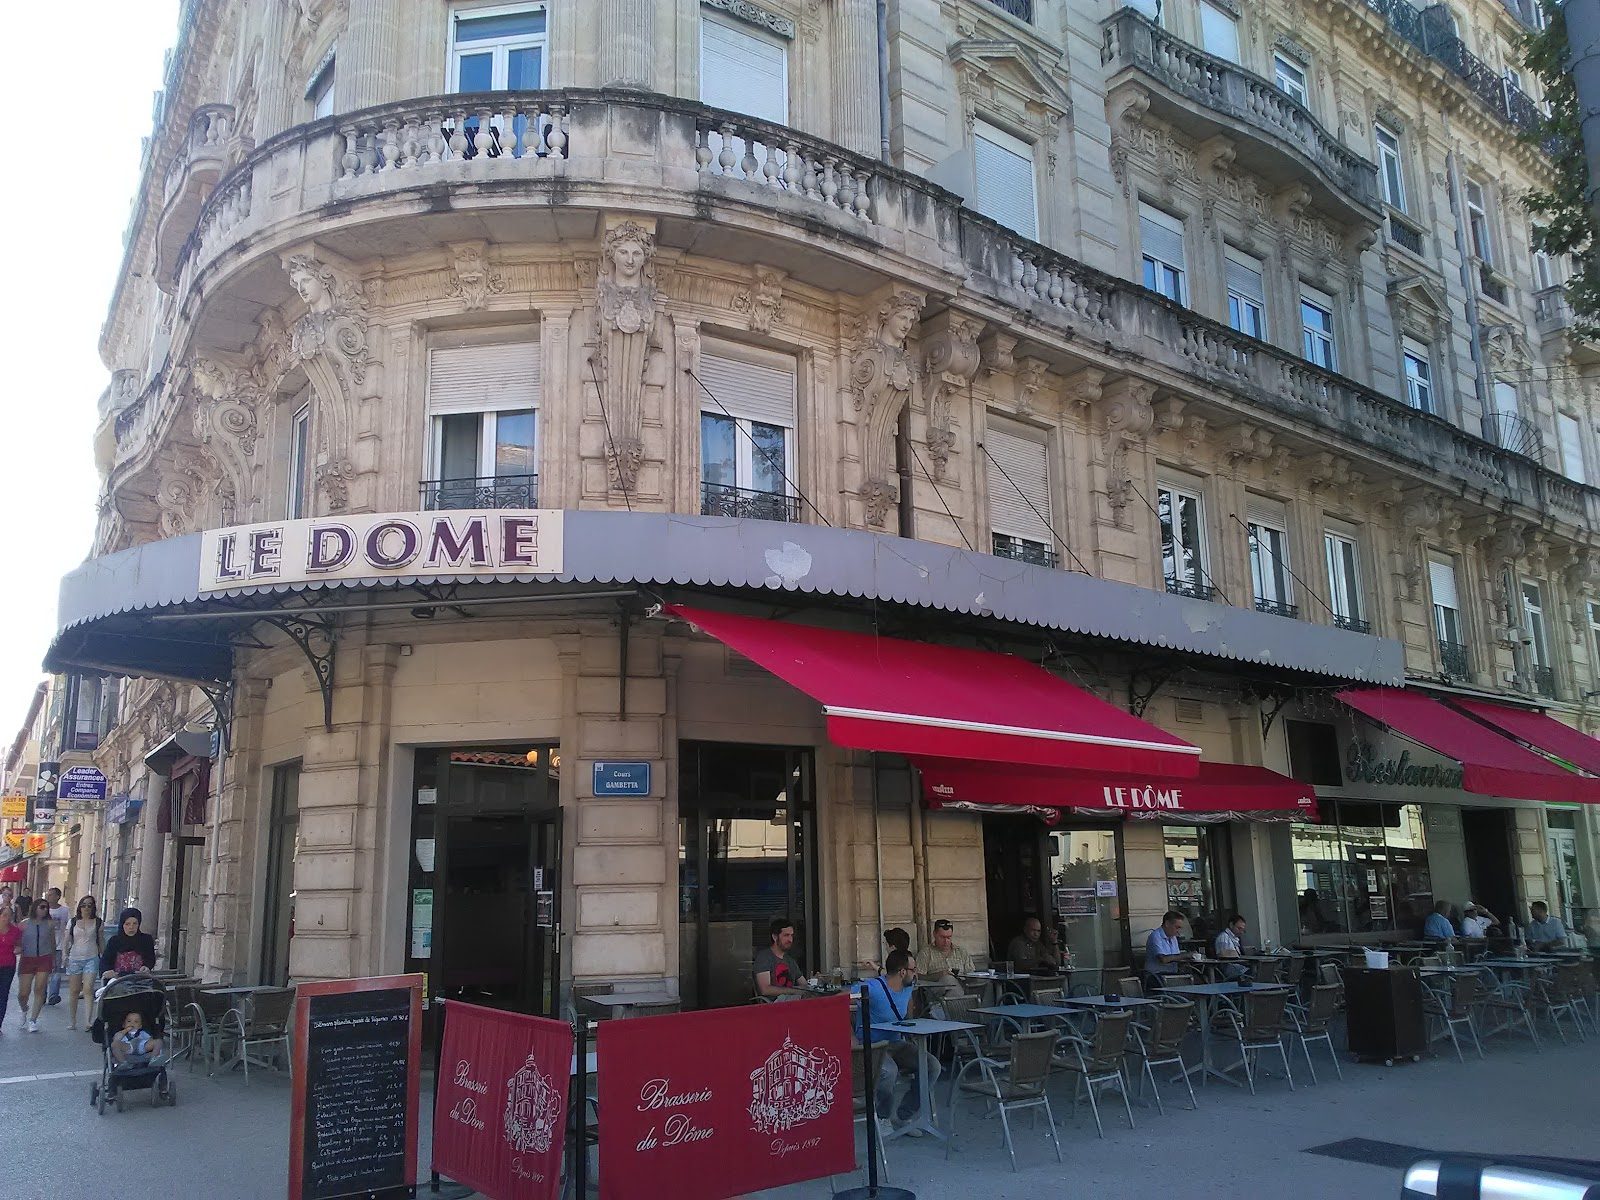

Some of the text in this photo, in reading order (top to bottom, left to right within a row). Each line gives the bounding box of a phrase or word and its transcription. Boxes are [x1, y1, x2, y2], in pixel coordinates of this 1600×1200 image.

[215, 515, 539, 584] LE DOME
[63, 773, 105, 782] Assurances
[72, 767, 97, 775] Leader
[613, 770, 632, 778] Cours
[605, 781, 639, 789] GAMBETTA
[1103, 784, 1184, 809] LE DÔME
[637, 1078, 713, 1112] Brasserie
[636, 1113, 714, 1152] du Dôme
[769, 1136, 821, 1158] Depuis 1897
